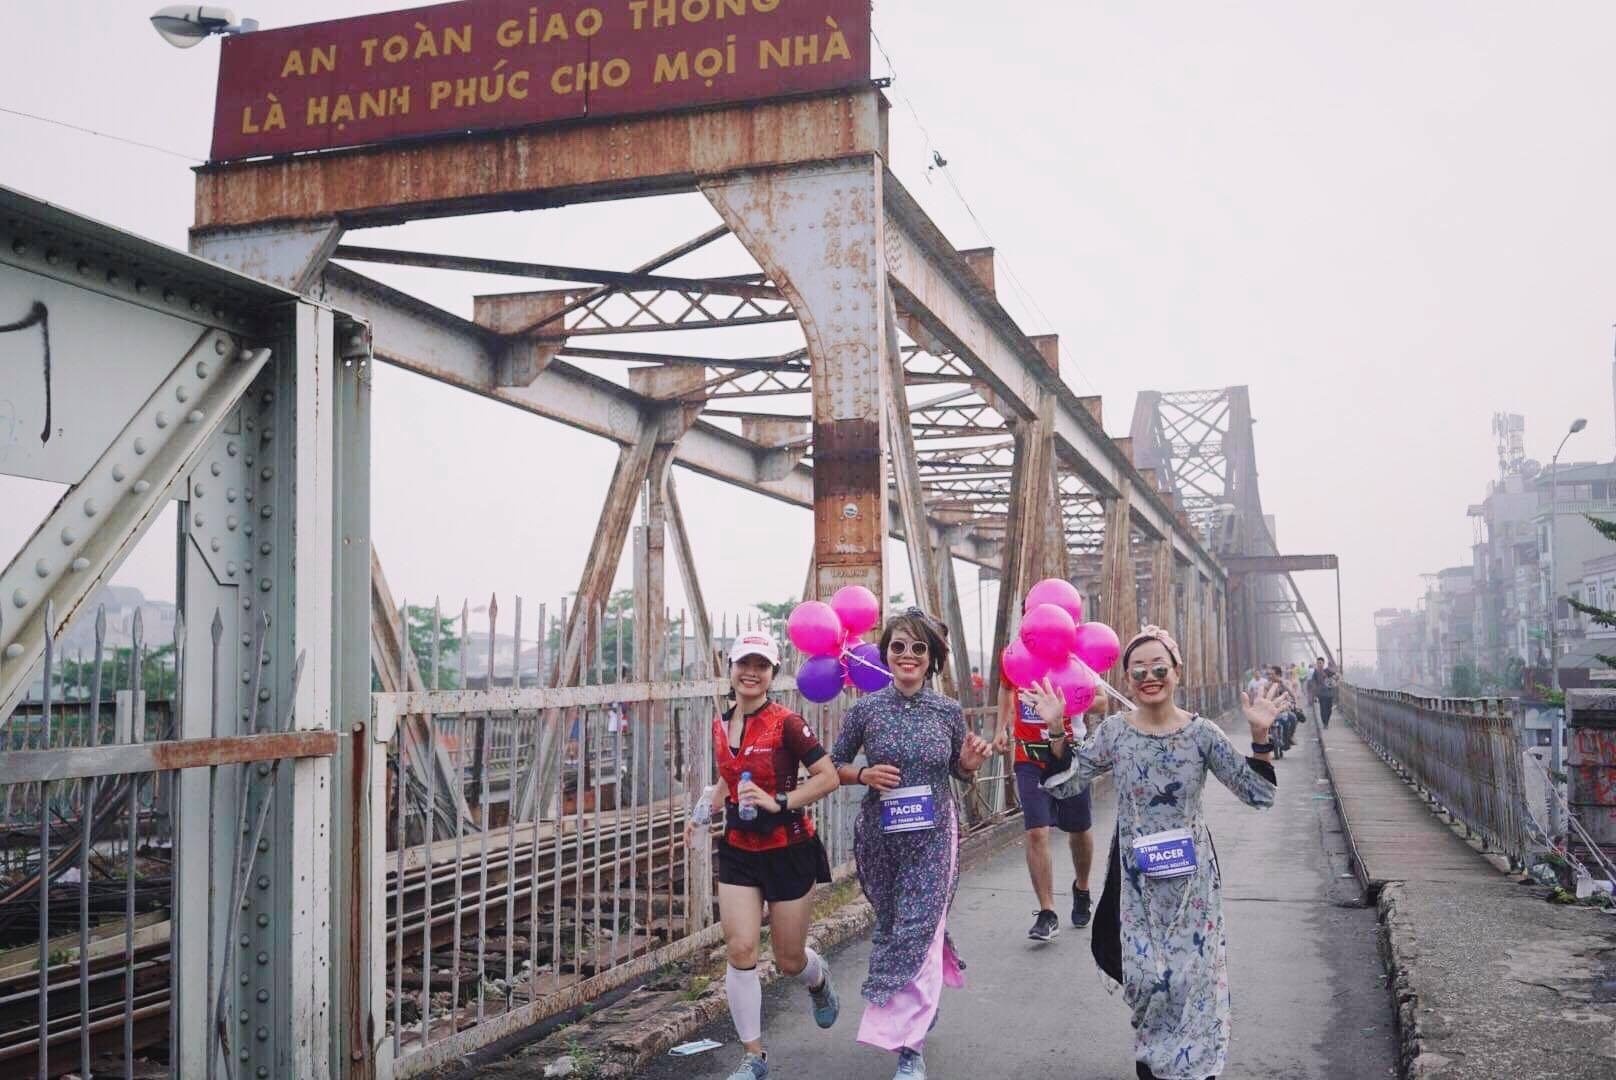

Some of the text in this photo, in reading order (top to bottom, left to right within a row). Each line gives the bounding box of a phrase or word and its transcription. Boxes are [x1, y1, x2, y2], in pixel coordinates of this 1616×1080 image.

[281, 44, 337, 77] AN
[361, 22, 473, 67] TOÀN
[241, 92, 287, 134] LÀ
[306, 86, 411, 131] HẠNH
[430, 59, 530, 110] PHÚC
[551, 58, 631, 95] CHO
[759, 15, 852, 70] NHÀ
[889, 803, 923, 816] PACER
[1149, 848, 1184, 863] PACER
